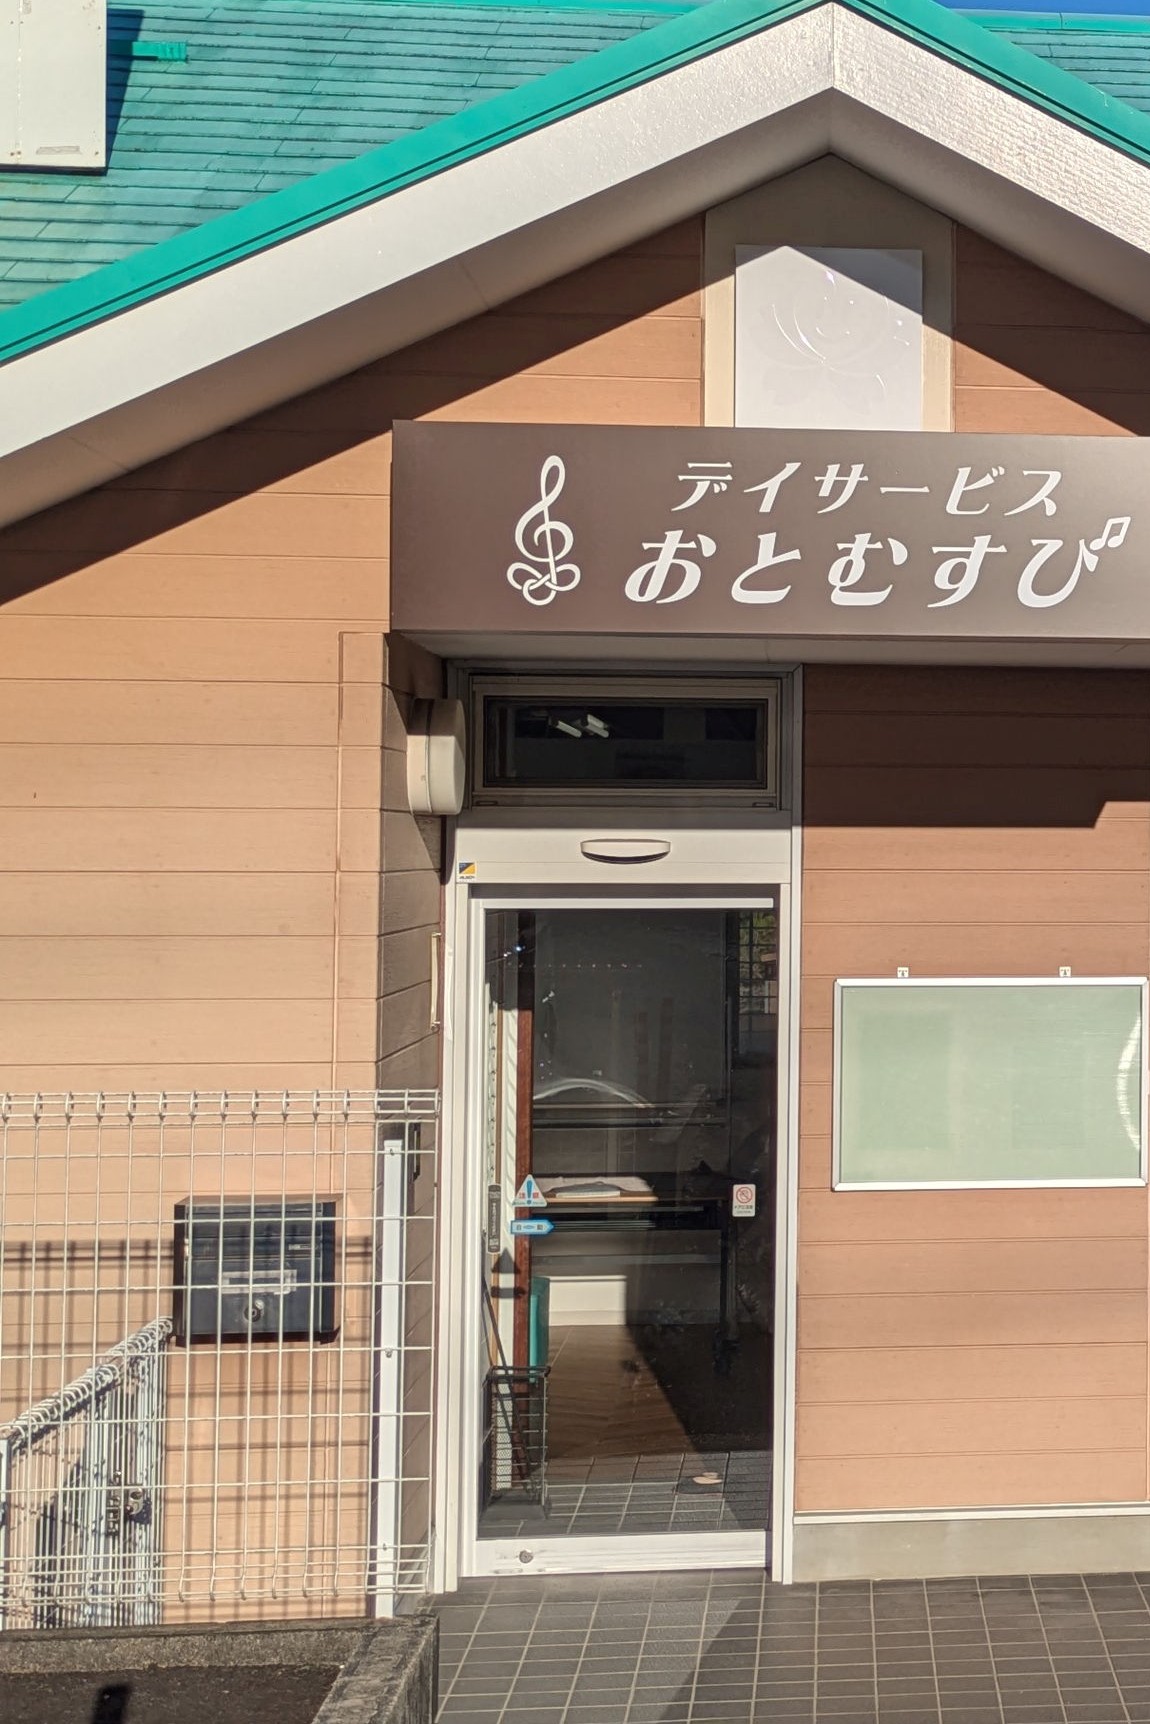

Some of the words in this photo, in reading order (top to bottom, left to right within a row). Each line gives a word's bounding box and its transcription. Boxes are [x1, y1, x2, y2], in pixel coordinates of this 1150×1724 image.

[671, 461, 1063, 517] デイサービス
